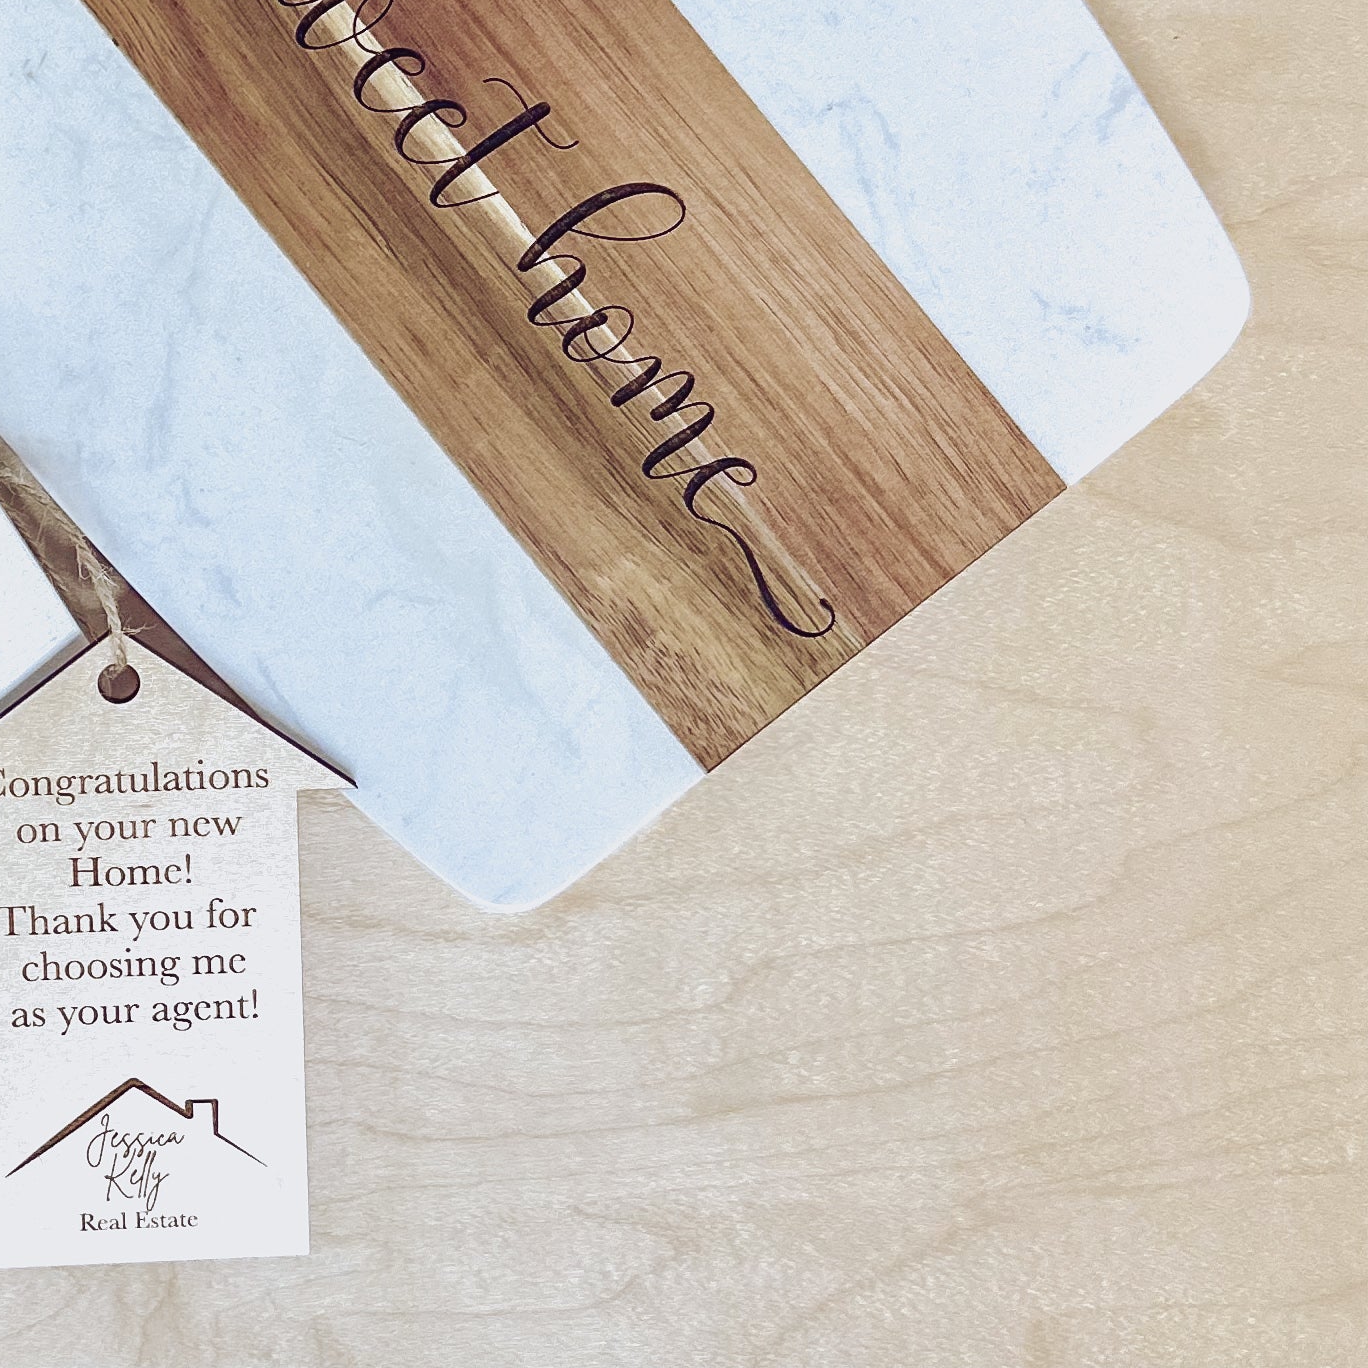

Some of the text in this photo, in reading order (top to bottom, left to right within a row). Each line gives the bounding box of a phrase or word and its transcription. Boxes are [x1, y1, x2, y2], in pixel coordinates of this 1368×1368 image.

[517, 182, 835, 637] home
[16, 813, 243, 851] on your new
[70, 854, 193, 888] Home!
[129, 908, 194, 941] you
[206, 897, 257, 929] for
[20, 947, 247, 986] choosing me
[11, 988, 260, 1035] as your agent!
[86, 1114, 185, 1166] Jessica
[104, 1148, 170, 1212] Kelly
[80, 1211, 199, 1232] Real Estate
